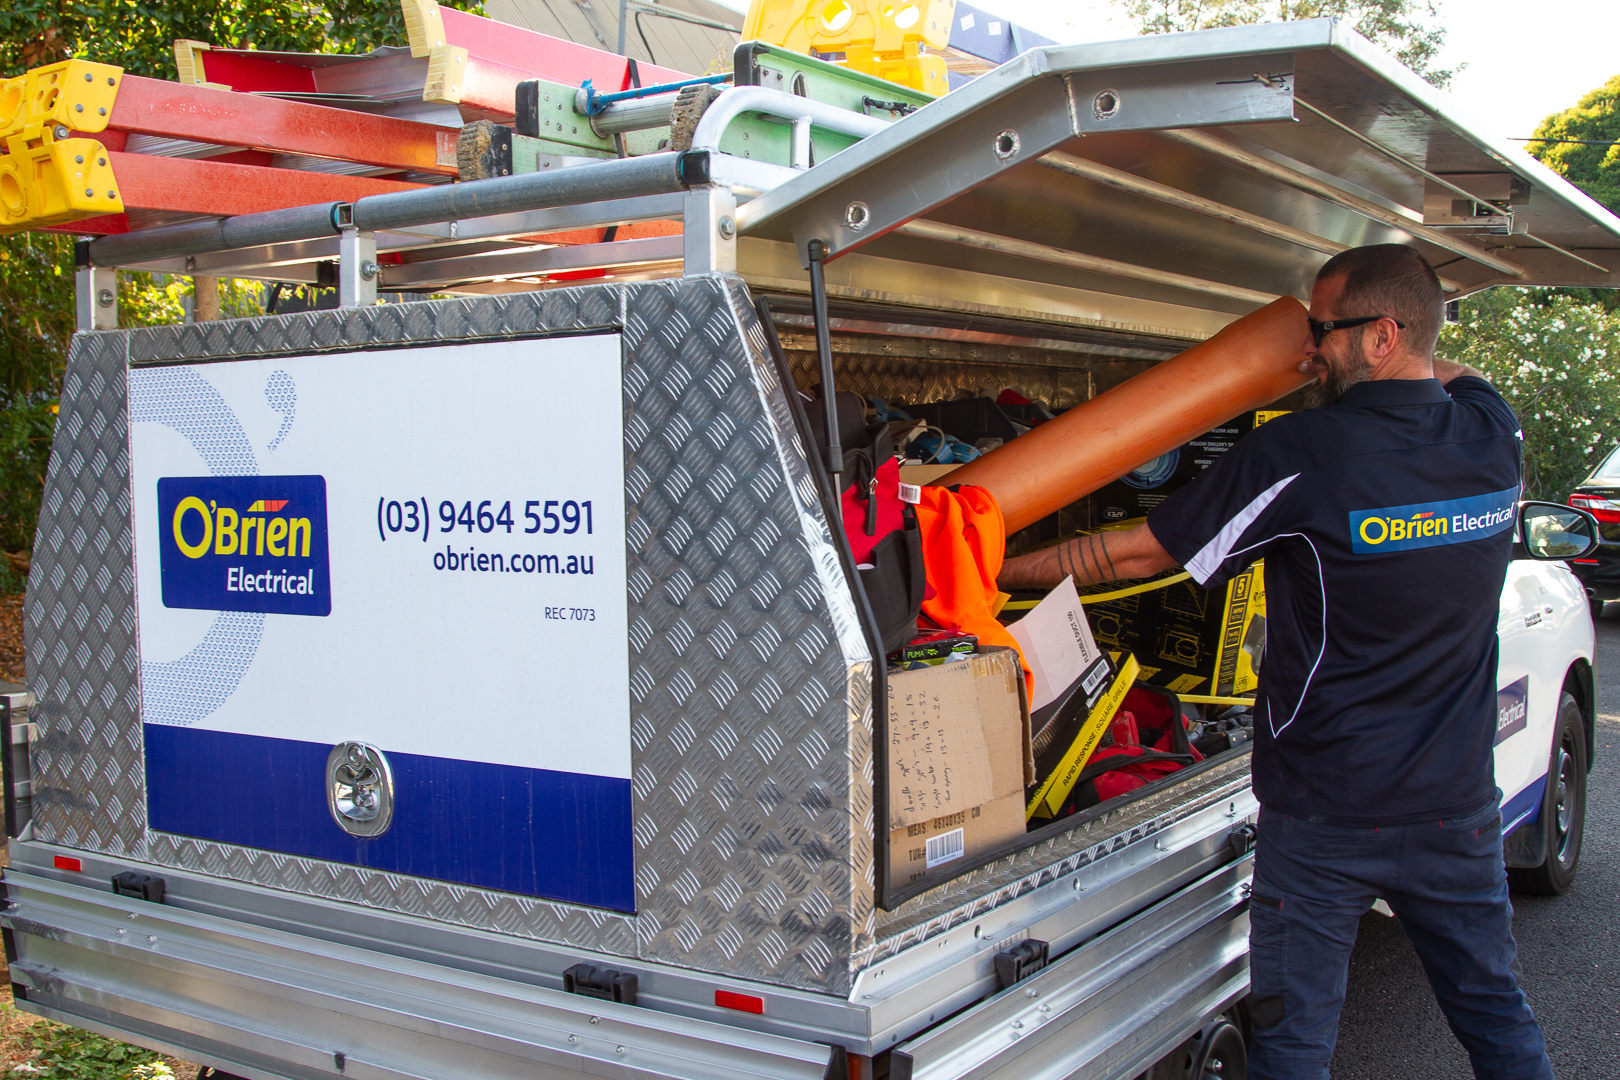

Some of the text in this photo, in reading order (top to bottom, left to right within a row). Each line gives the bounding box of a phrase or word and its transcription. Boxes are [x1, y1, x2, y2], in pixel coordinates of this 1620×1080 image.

[173, 496, 312, 559] O'Brien
[377, 496, 594, 543] (03) 9464 5591
[1359, 502, 1515, 545] O'Brien Electrical
[433, 546, 594, 575] obrien.com.au
[226, 566, 314, 596] Electrical
[544, 606, 596, 622] REC 7073
[907, 650, 925, 659] PUMA
[1498, 694, 1527, 731] Electrical
[1062, 765, 1077, 787] RAPID
[1096, 702, 1115, 732] SQUARE
[1112, 680, 1127, 703] GRILLE
[907, 822, 929, 838] MEAS.
